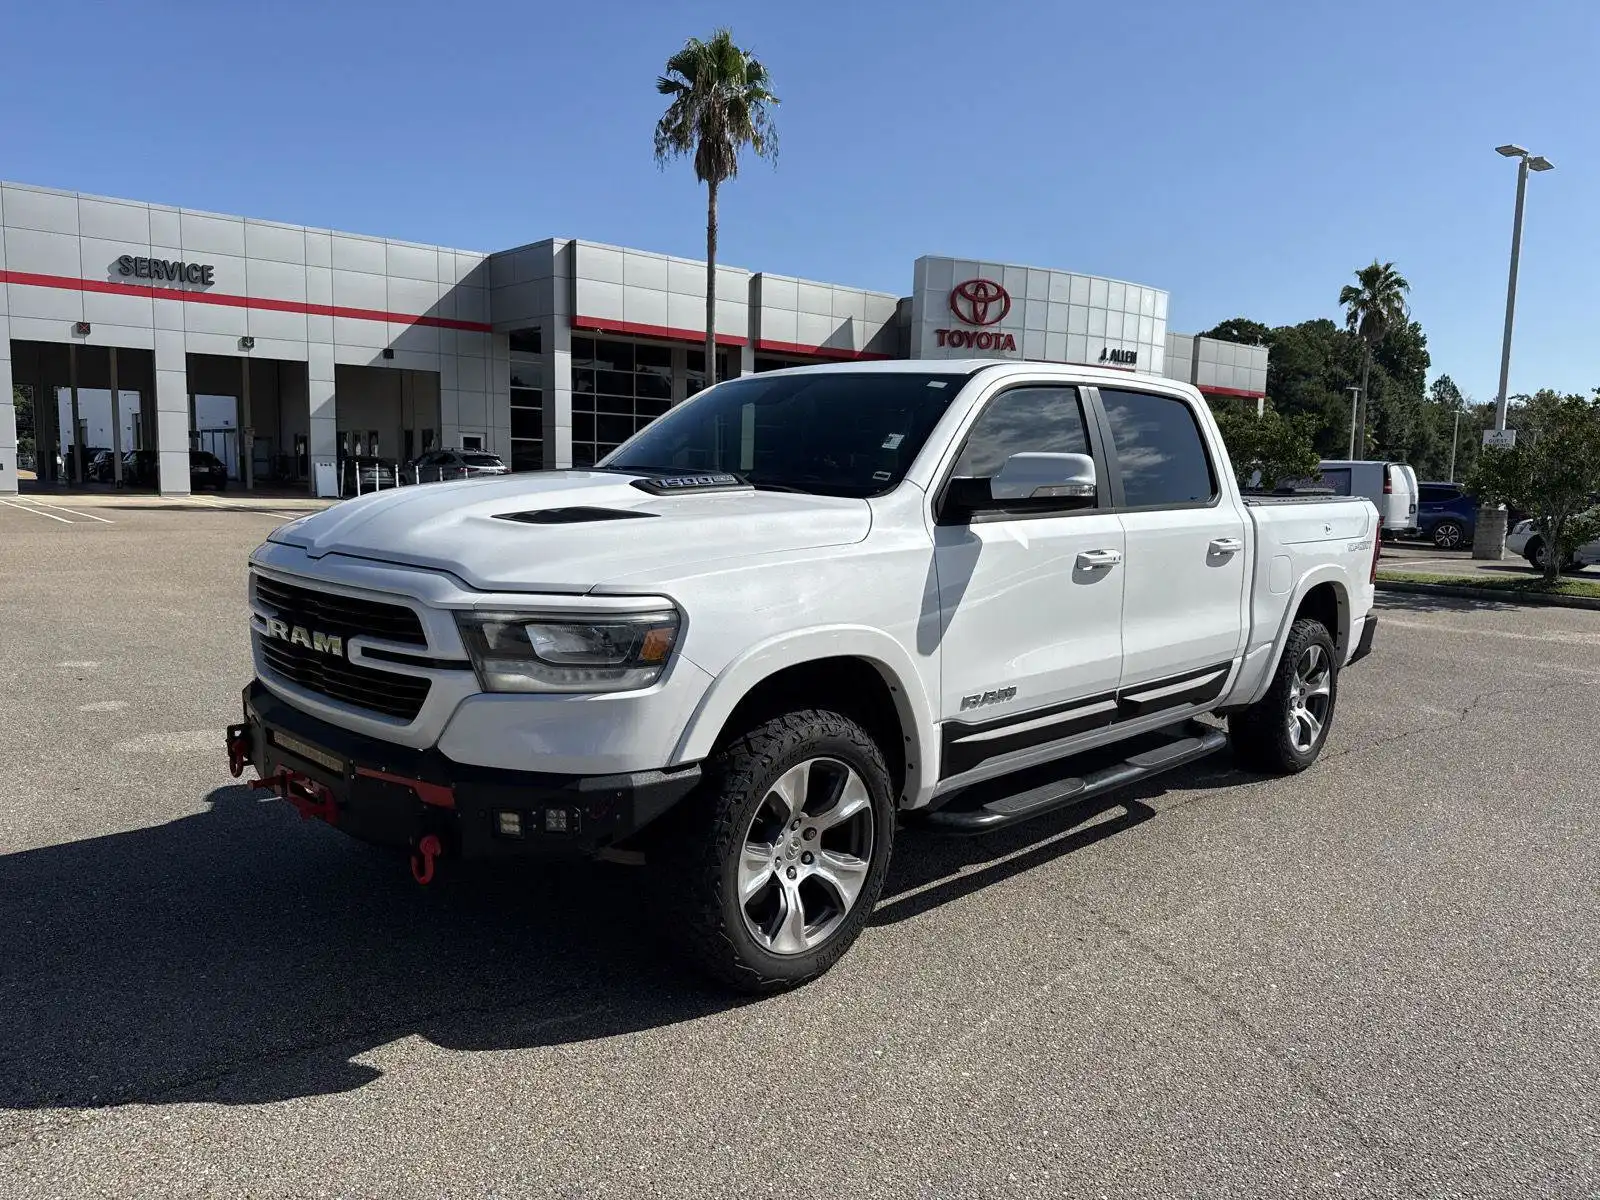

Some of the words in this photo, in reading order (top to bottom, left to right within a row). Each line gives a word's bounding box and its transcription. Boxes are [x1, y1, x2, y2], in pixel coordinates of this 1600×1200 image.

[118, 254, 215, 286] SERVICE
[935, 329, 1016, 351] TOYOTA
[1100, 347, 1109, 361] J.
[1110, 348, 1138, 364] ALLEN
[661, 475, 714, 488] 1500
[267, 618, 343, 657] RAM
[960, 685, 1017, 712] RAM
